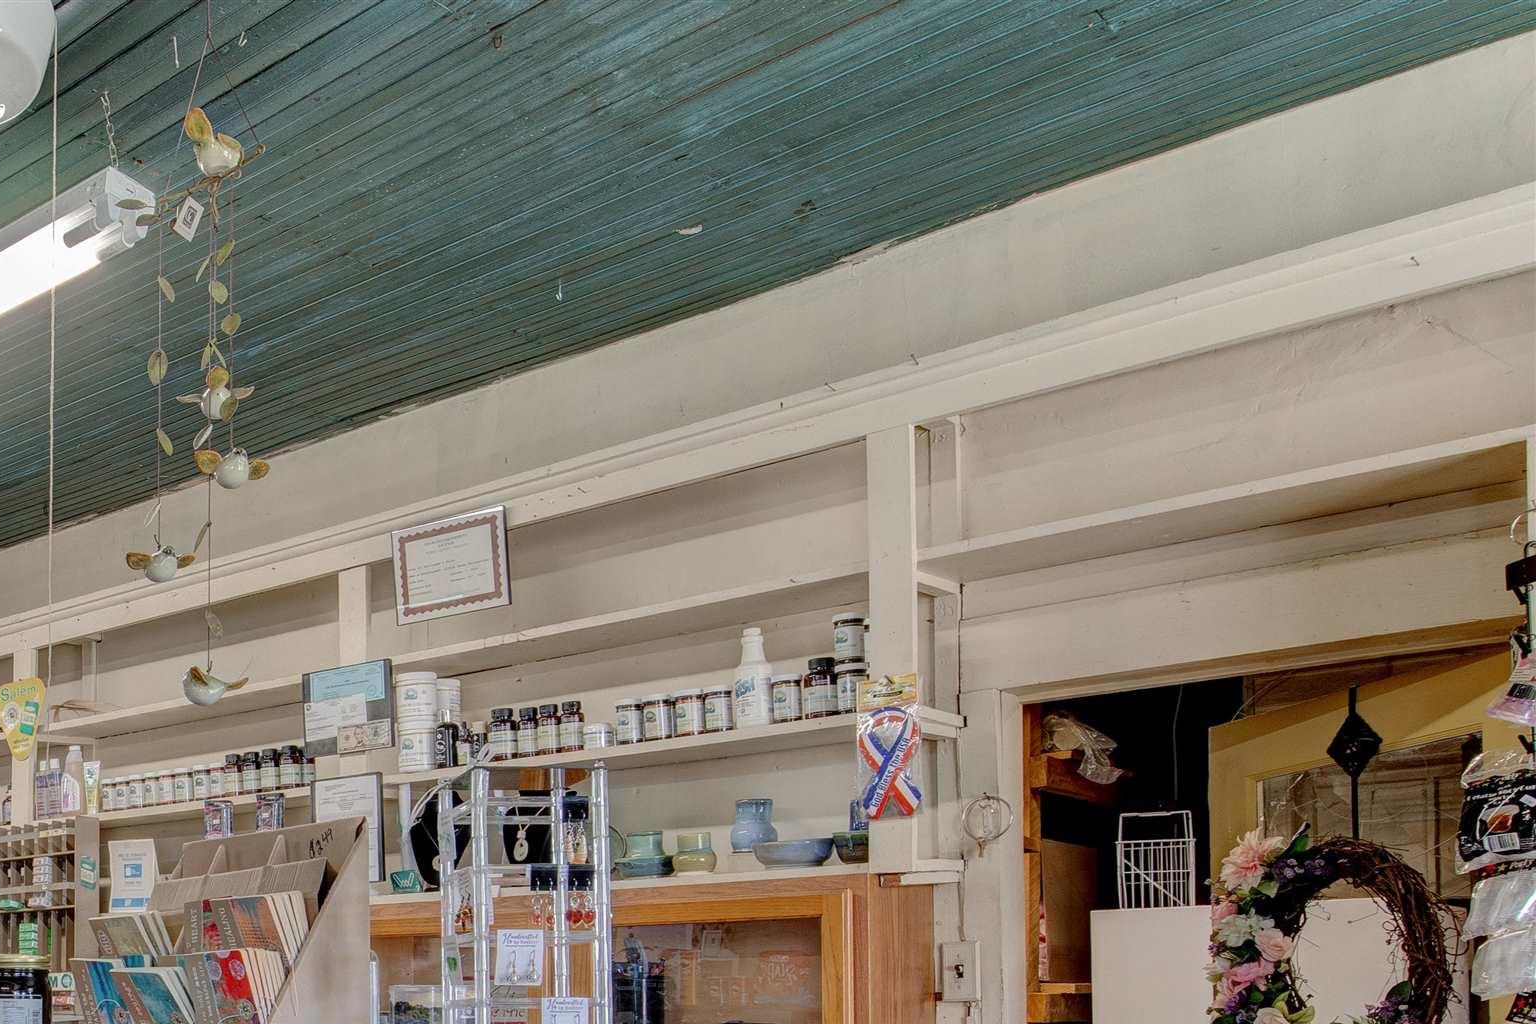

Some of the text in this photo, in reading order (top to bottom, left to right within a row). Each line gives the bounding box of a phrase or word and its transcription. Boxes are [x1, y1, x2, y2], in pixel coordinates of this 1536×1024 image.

[871, 736, 912, 808] God Bless the USA
